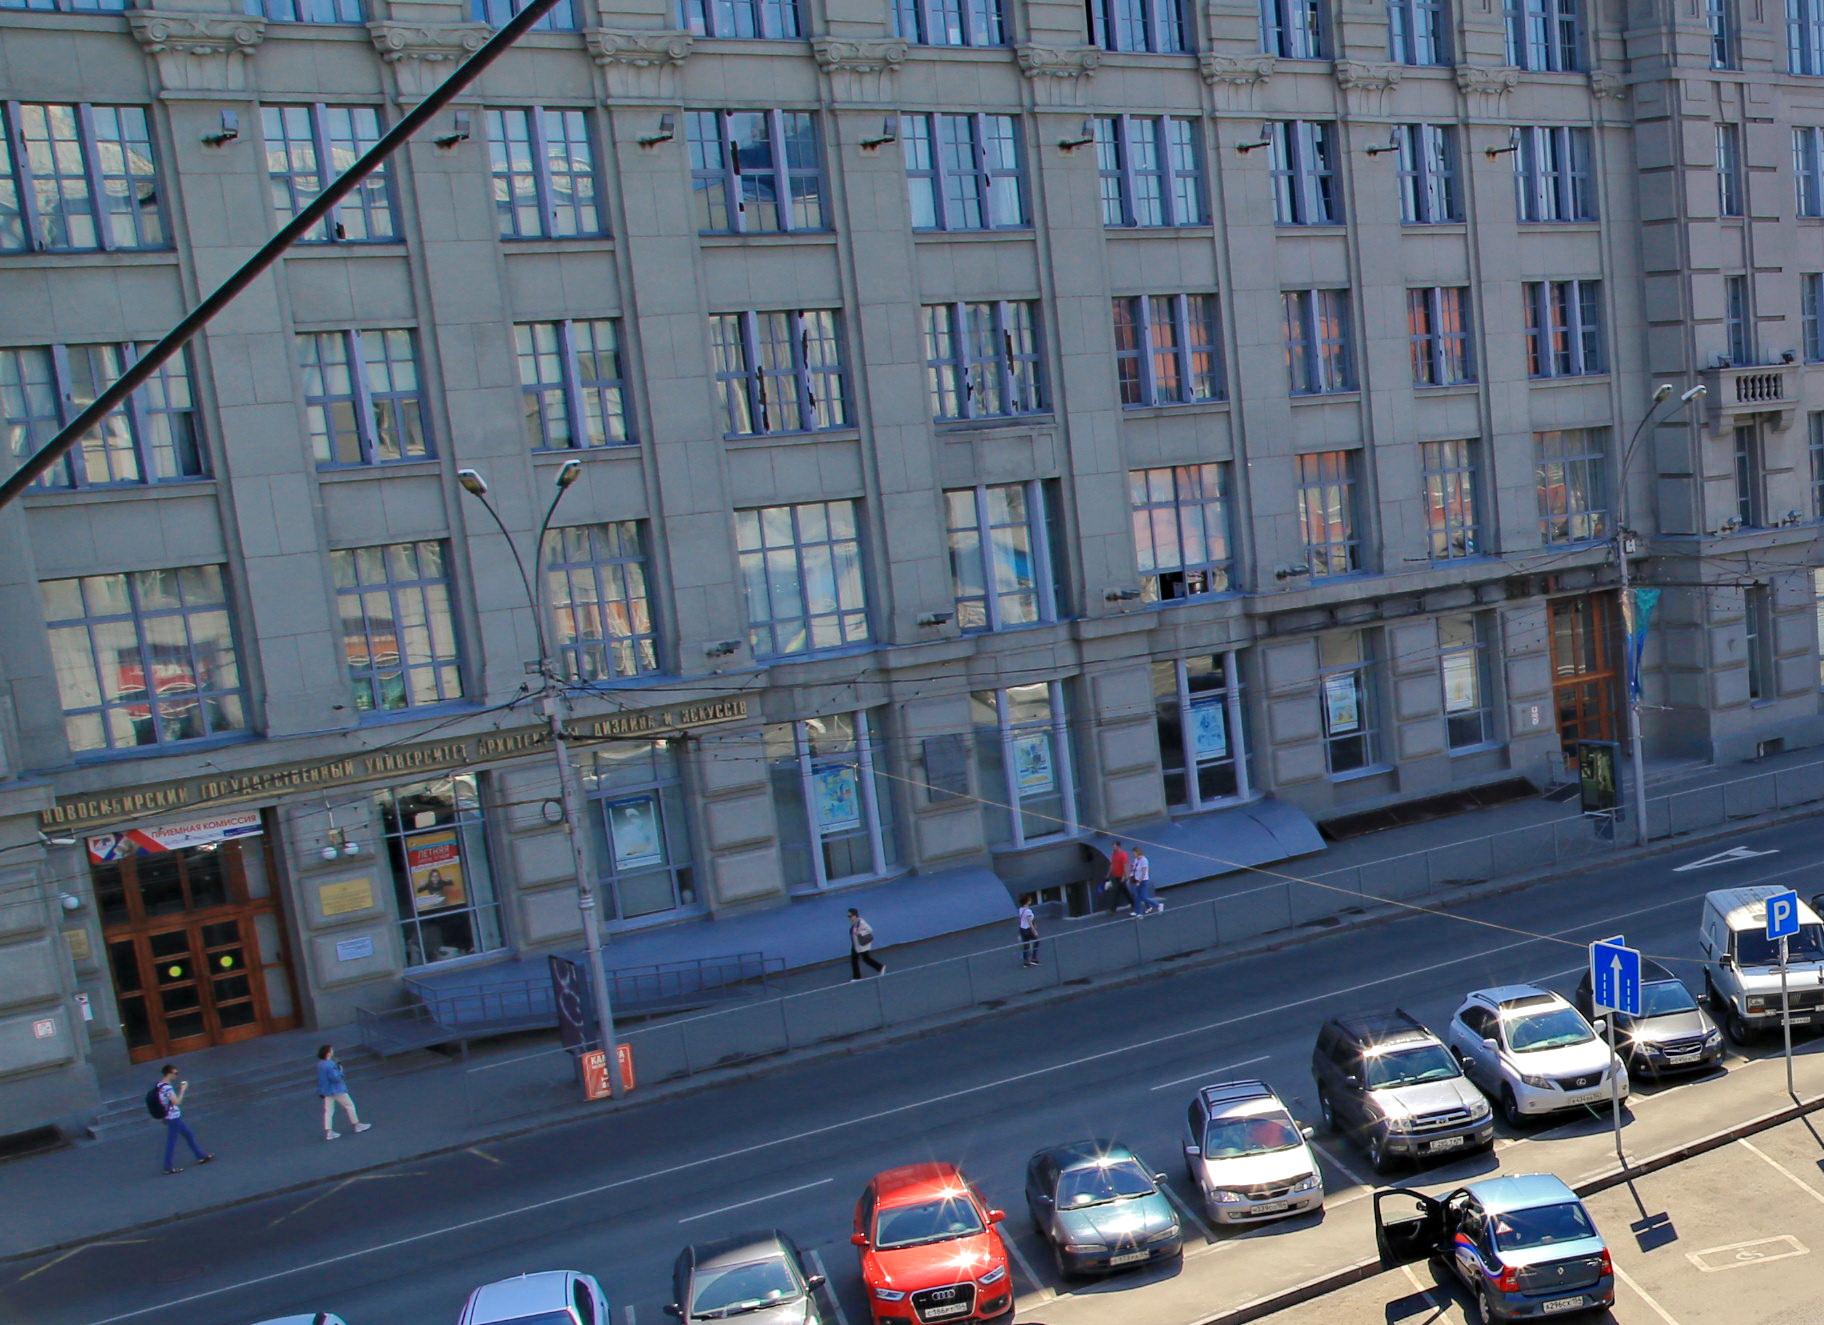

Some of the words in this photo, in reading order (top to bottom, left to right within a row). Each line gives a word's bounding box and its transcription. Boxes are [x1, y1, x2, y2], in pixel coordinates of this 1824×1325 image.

[42, 786, 189, 824] НОВОСИБИРСКИЙ
[365, 743, 469, 774] УНИВЕРСИТЕТ
[594, 716, 656, 736] ДИЗАЙНА
[664, 712, 673, 727] И
[682, 700, 749, 722] ИСКУССТВ
[203, 814, 257, 830] КОМИССИЯ
[1773, 900, 1791, 932] P
